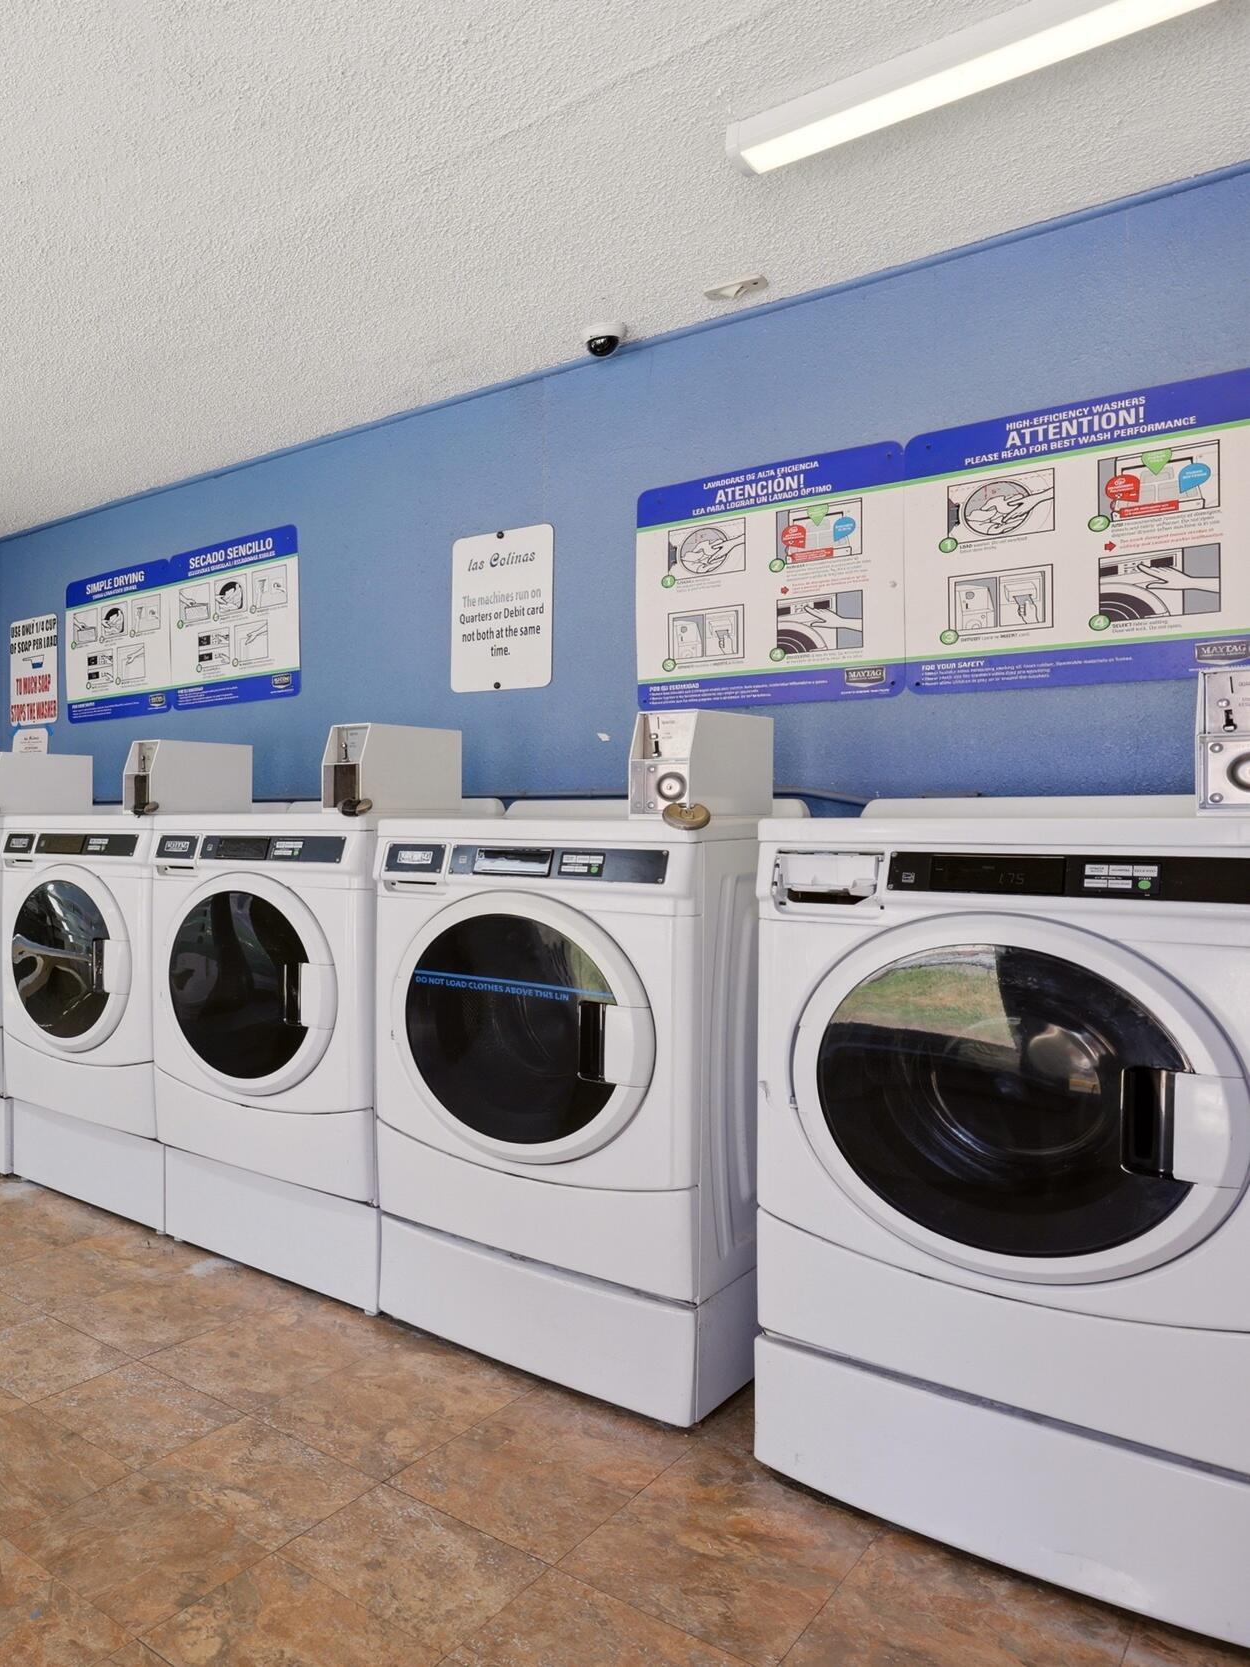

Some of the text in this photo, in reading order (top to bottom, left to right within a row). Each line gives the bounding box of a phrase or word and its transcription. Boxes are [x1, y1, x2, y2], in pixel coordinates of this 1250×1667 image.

[1005, 396, 1146, 431] HIGH-EFFICIENCY WASHERS
[1005, 406, 1145, 449] ATTENTION!
[964, 415, 1197, 466] PLEASE READ FOR BEST WASH PERFORMANCE
[703, 460, 819, 490] LAVADORAS DE ALTA EFICIENCIA
[715, 473, 805, 503] ATENCIÓN!
[692, 508, 705, 516] LEA
[706, 504, 725, 514] PARA
[726, 499, 755, 510] LOGRAR
[756, 496, 768, 504] UN
[769, 491, 799, 502] LAVADO
[189, 537, 273, 570] SECADO SENCILLO
[467, 551, 536, 572] las Colinas
[86, 578, 113, 595] SIMPLE
[113, 570, 145, 588] DRYING
[462, 588, 542, 609] The machines run on
[459, 603, 545, 625] Quarters or Debit card
[11, 626, 21, 638] USE
[22, 622, 34, 636] ONLY
[45, 618, 56, 631] CUP
[462, 624, 541, 642] not both at the same
[17, 640, 32, 654] SOAP
[32, 637, 43, 651] PER
[490, 644, 511, 657] time.
[1202, 644, 1247, 655] MAYTAG
[848, 668, 883, 680] MAYTAG
[957, 660, 985, 669] SAFETY
[38, 673, 51, 693] SOAP
[11, 703, 26, 722] STOPS
[36, 699, 57, 720] WASHER
[415, 975, 427, 984] DO
[428, 978, 445, 986] NOT
[445, 979, 467, 988] LOAD
[468, 982, 503, 993] CLOTHES
[505, 986, 533, 997] ABOVE
